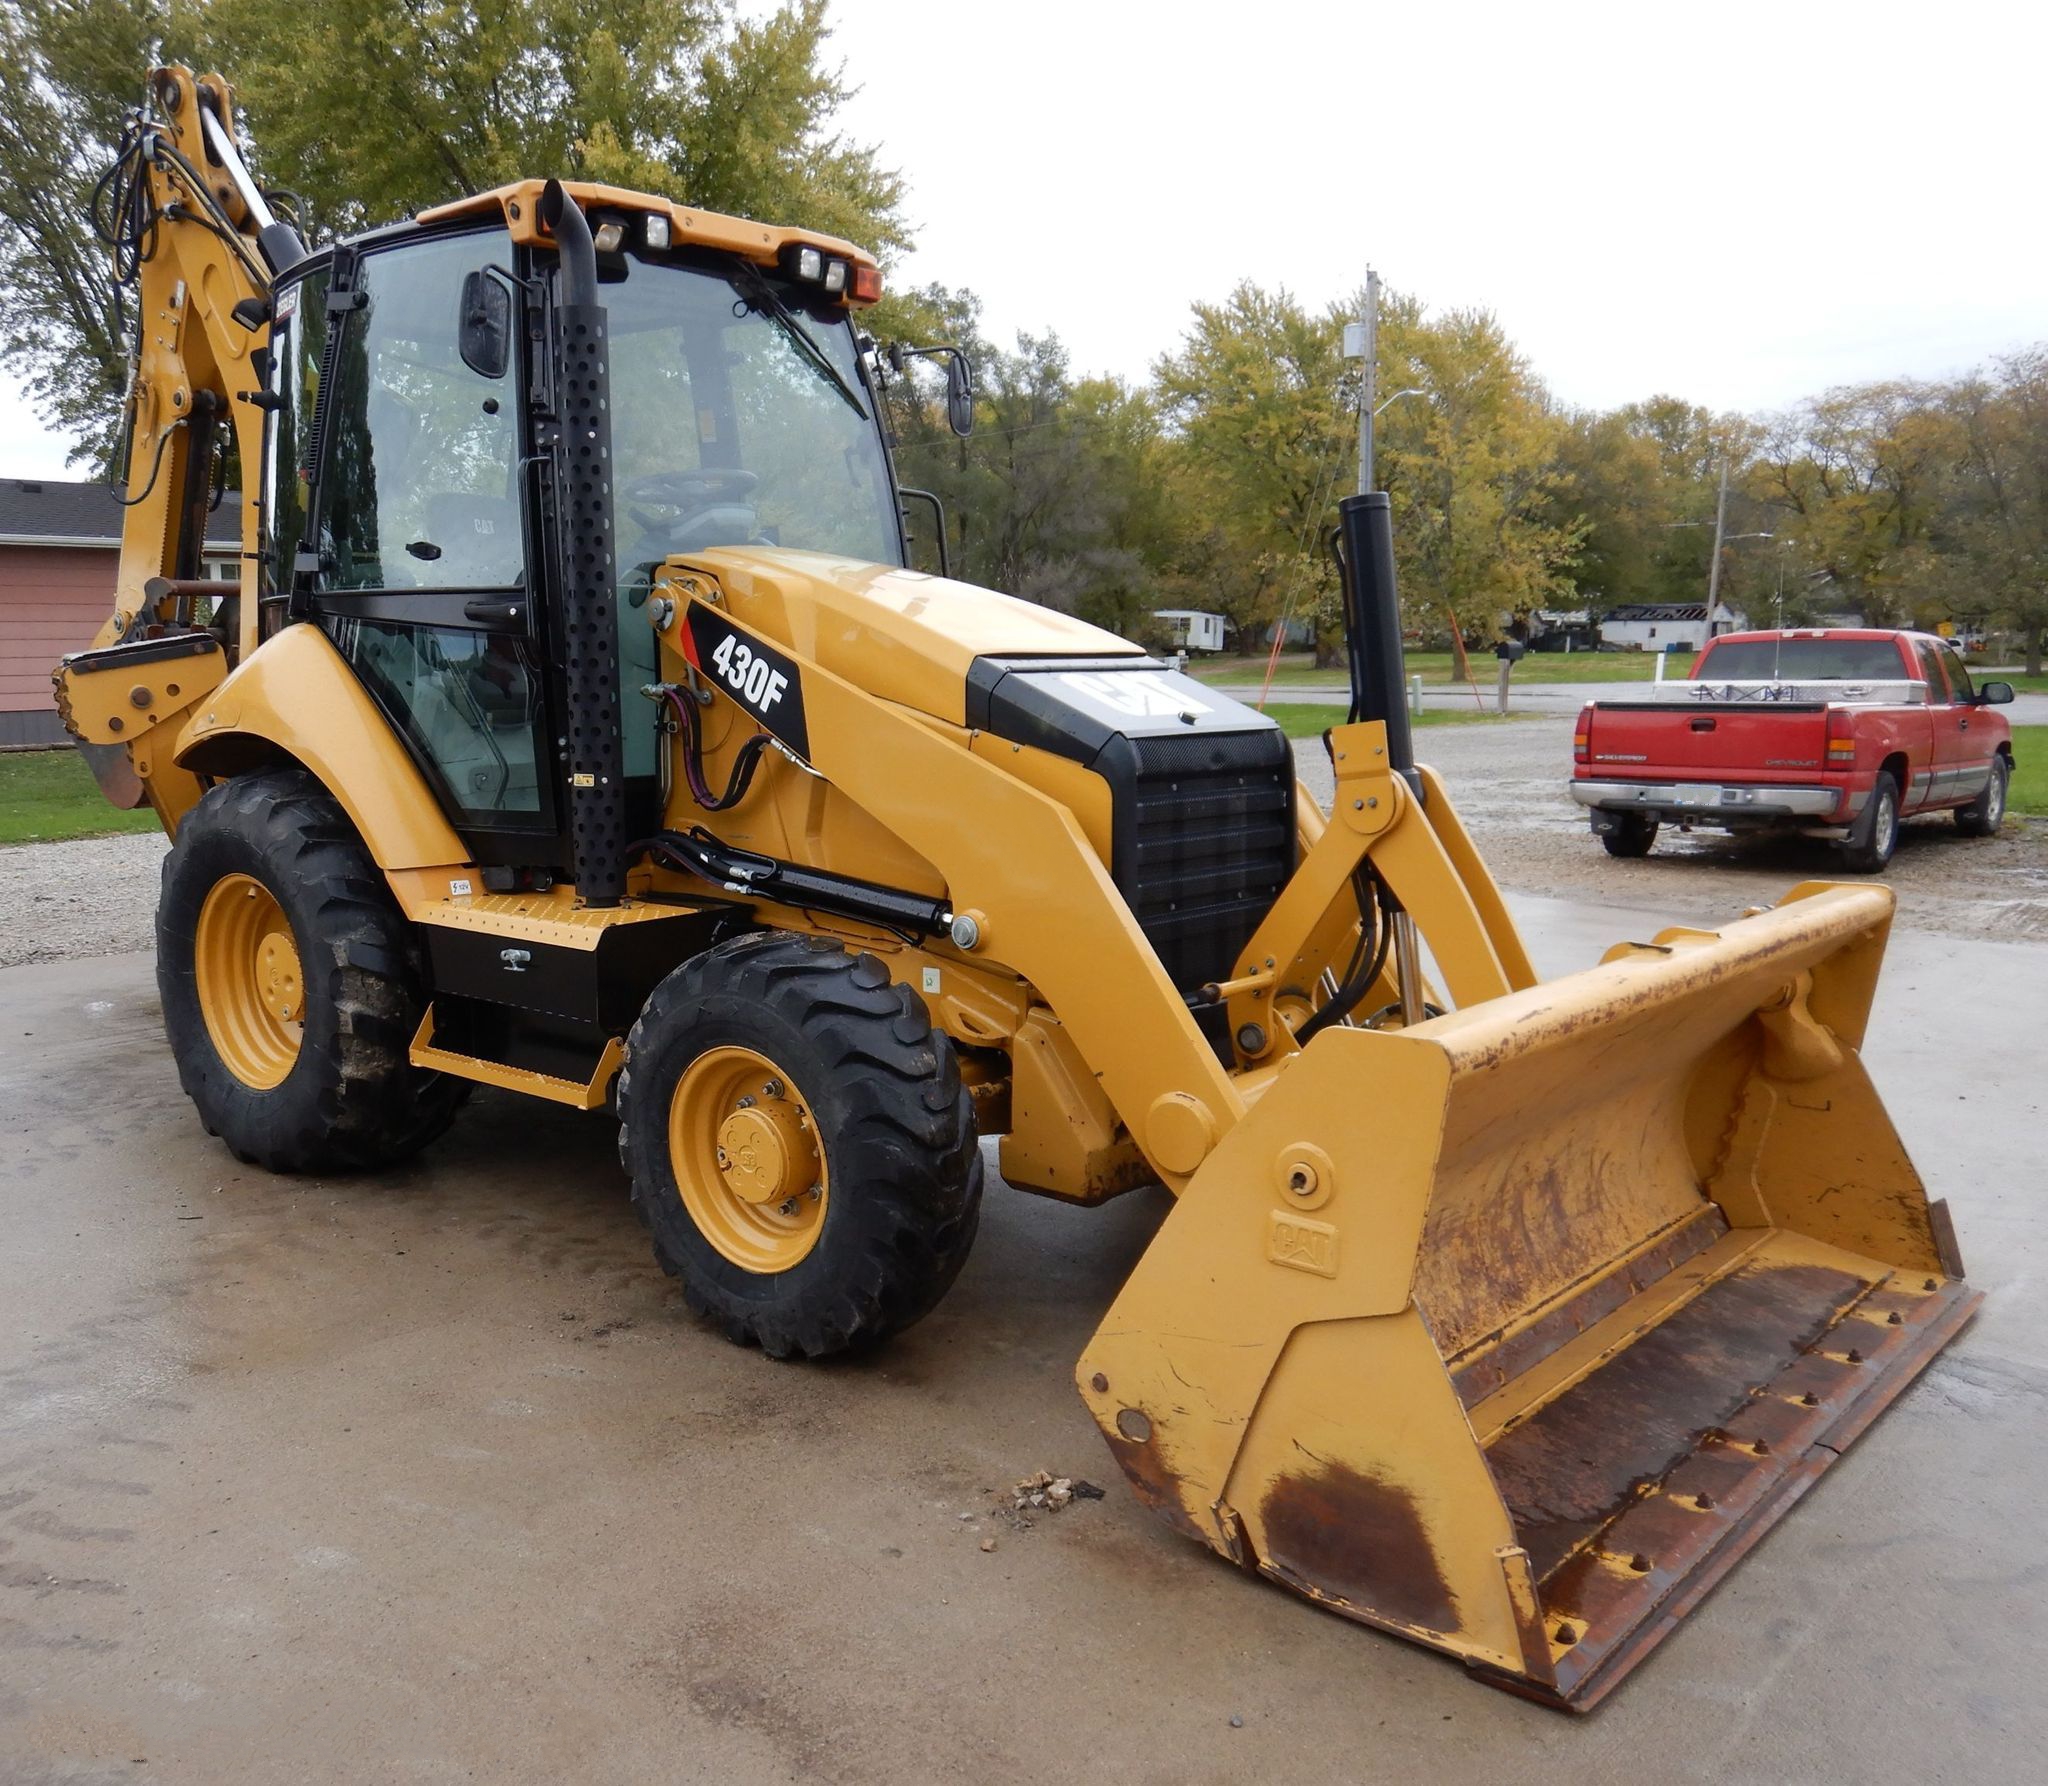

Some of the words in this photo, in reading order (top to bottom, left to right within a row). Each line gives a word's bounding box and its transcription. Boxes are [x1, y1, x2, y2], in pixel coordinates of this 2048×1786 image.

[474, 518, 495, 535] CAT
[712, 634, 788, 713] 430F
[1059, 671, 1215, 716] CAT
[1274, 1222, 1330, 1268] CAT
